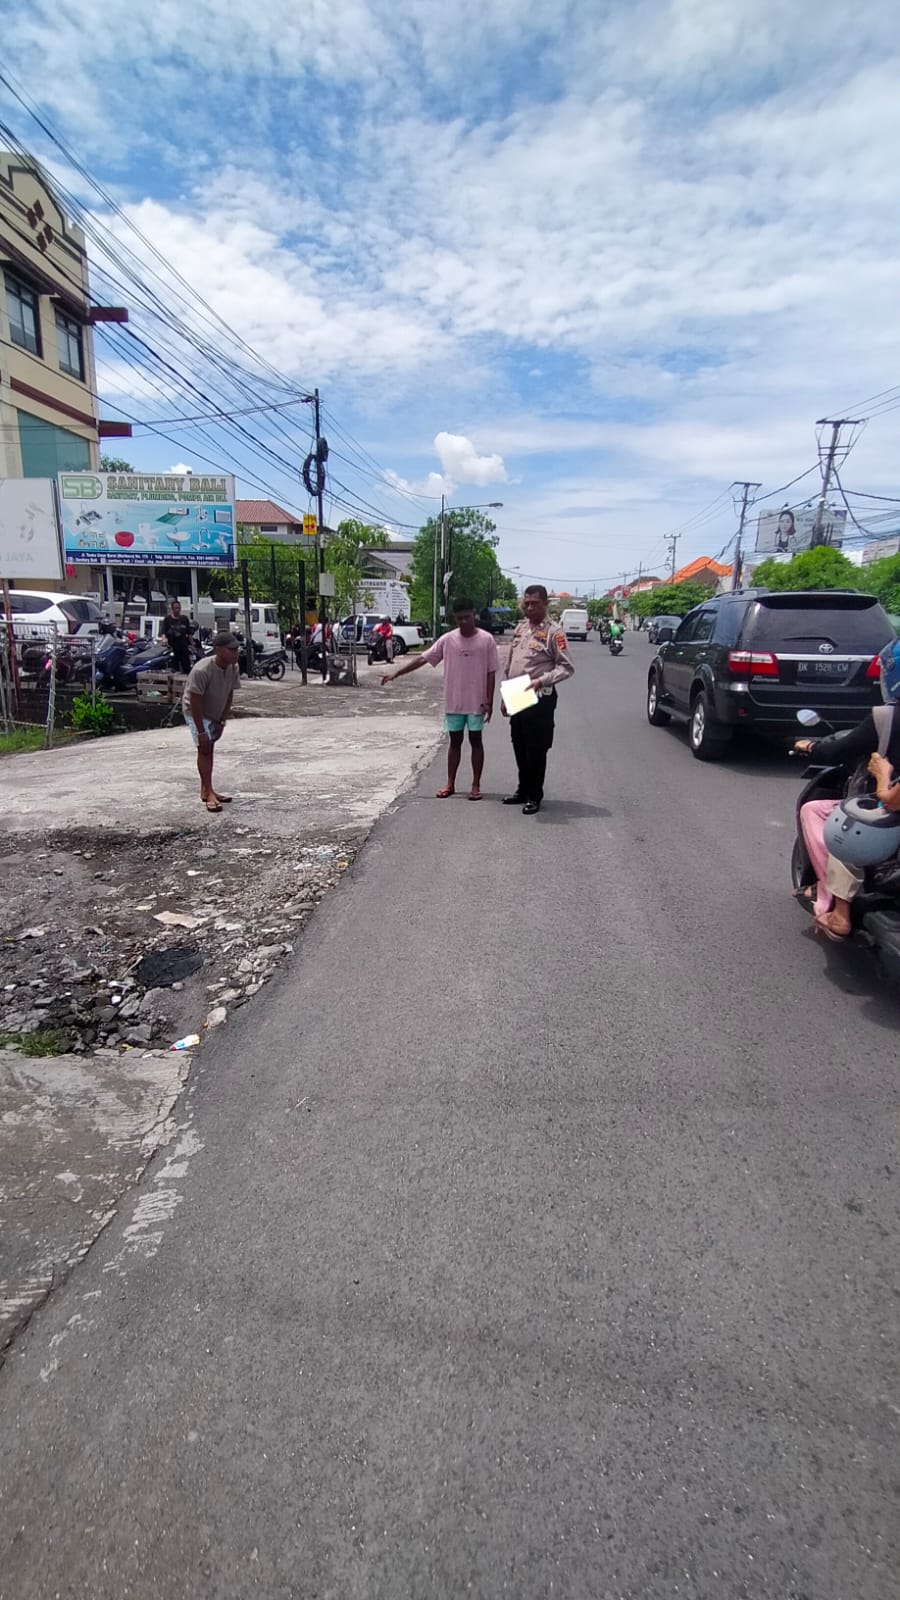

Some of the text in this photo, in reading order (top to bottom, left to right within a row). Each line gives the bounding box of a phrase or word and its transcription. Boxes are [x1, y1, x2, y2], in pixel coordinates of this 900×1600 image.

[107, 476, 227, 492] SANITARY BALI
[5, 551, 33, 561] JAYA
[798, 662, 808, 672] DK
